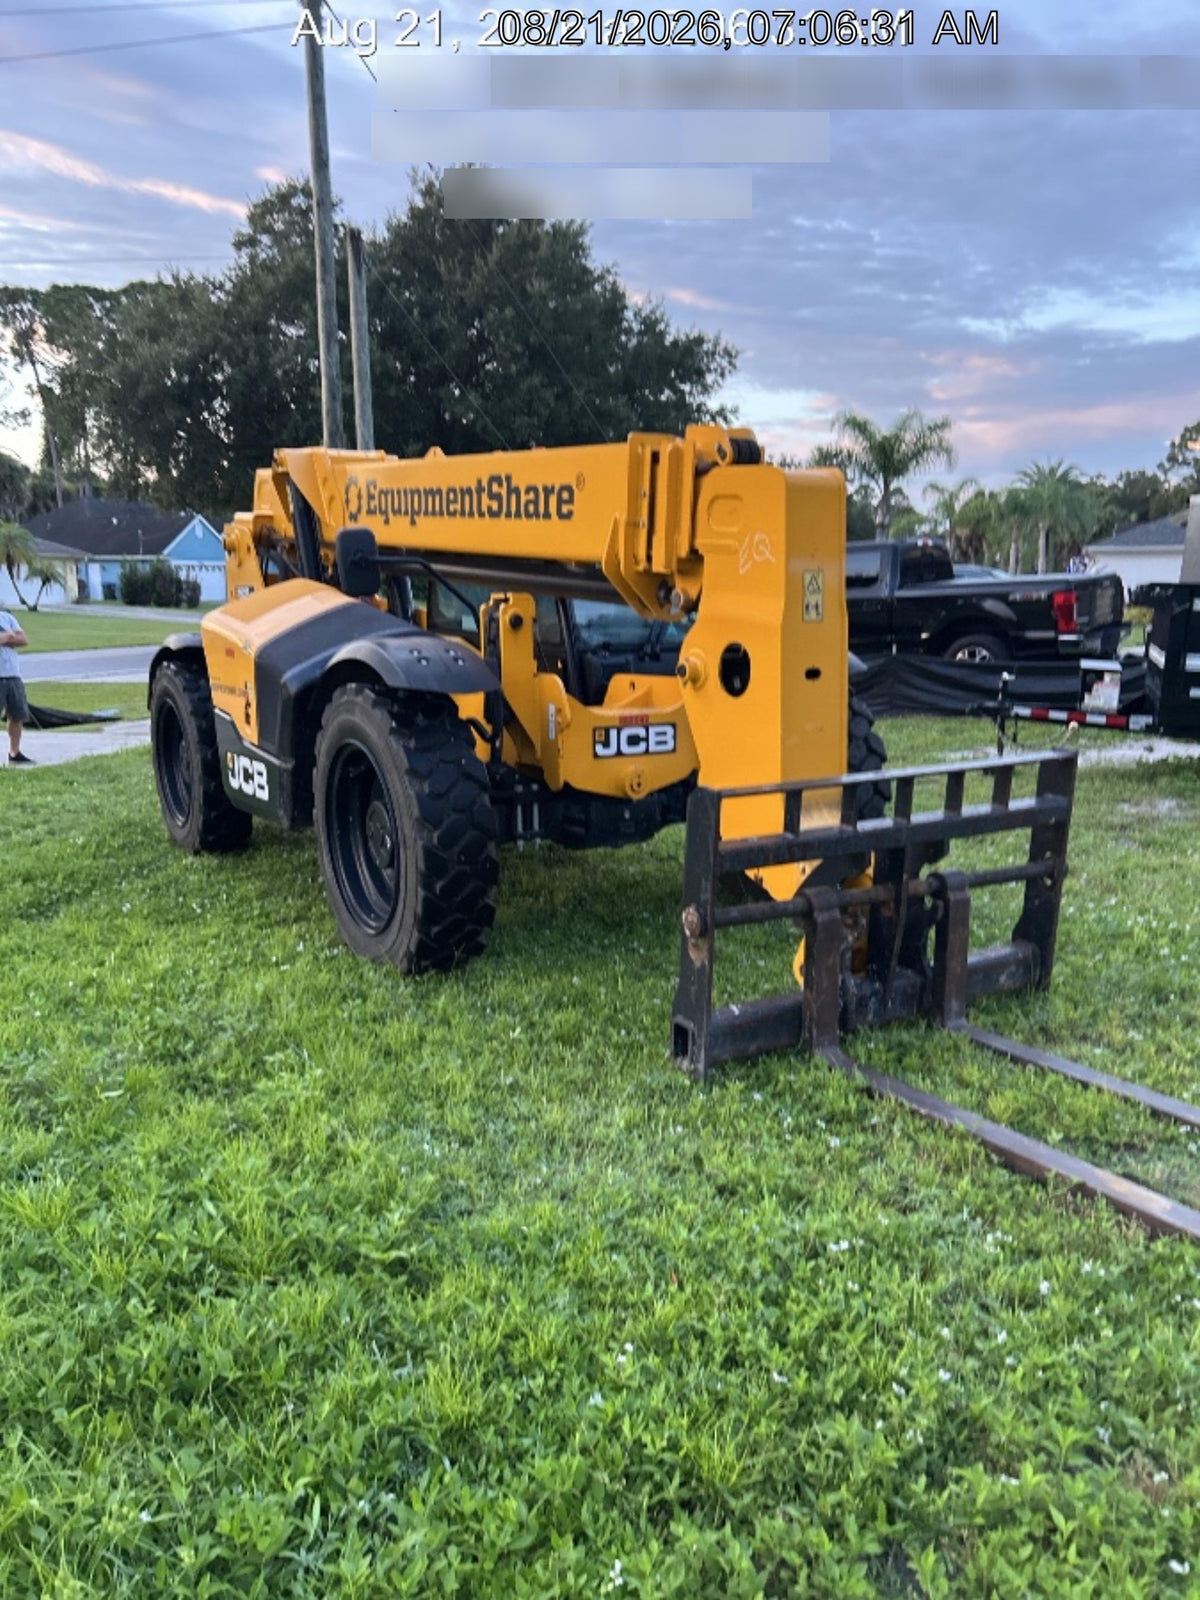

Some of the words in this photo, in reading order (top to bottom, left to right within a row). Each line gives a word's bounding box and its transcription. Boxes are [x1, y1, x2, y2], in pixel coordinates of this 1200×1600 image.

[364, 472, 576, 527] EquipmentShare
[594, 724, 675, 757] JCB
[227, 751, 270, 801] JCB
